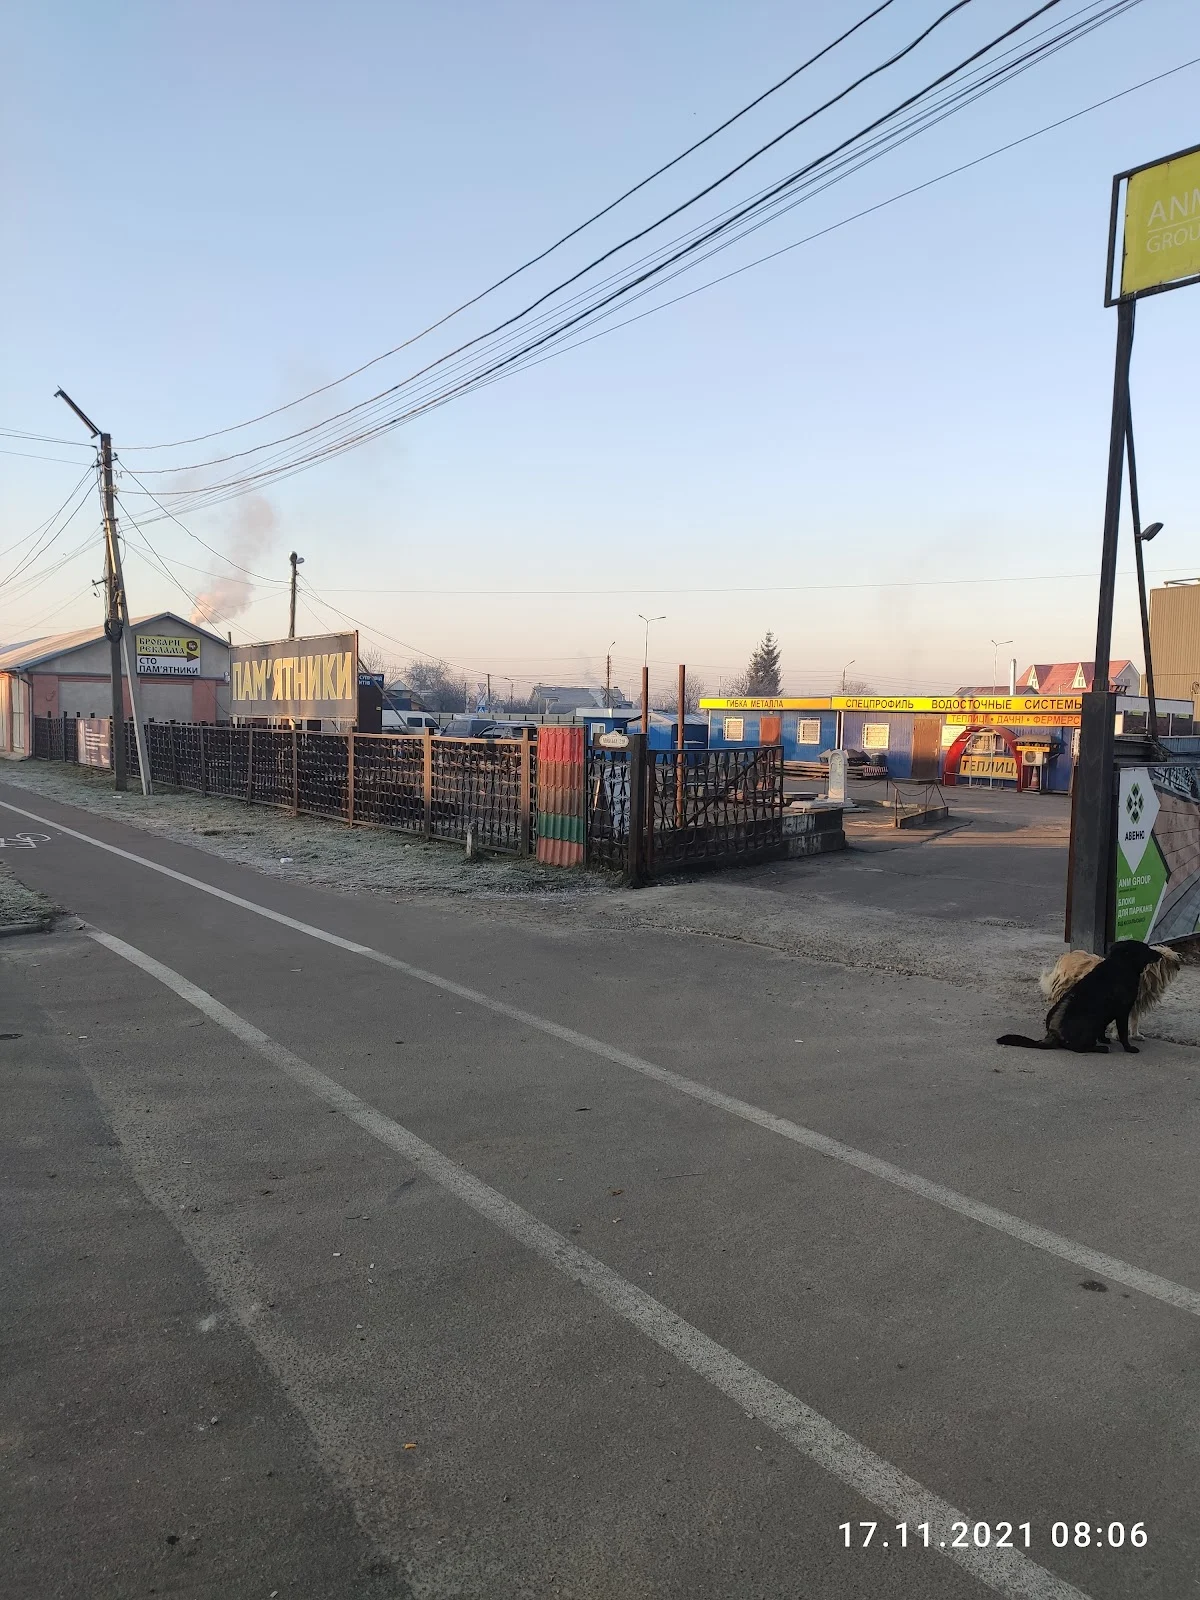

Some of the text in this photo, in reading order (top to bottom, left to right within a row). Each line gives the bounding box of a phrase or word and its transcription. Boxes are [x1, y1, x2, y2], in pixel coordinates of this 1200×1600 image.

[139, 637, 180, 647] БРОВАРИ
[139, 646, 185, 655] РЕКЛАМА
[139, 657, 157, 665] СТО
[232, 651, 353, 701] ПАМ'ЯТНИКИ
[726, 699, 784, 708] ГИБКА МЕТАЛЛА
[845, 698, 914, 710] СПЕЦПРОФИЛЬ
[931, 699, 1012, 711] ВОДОСТОЧНЫЕ
[962, 760, 1018, 776] ТЕПЛИЦ
[1132, 874, 1151, 886] GROUP
